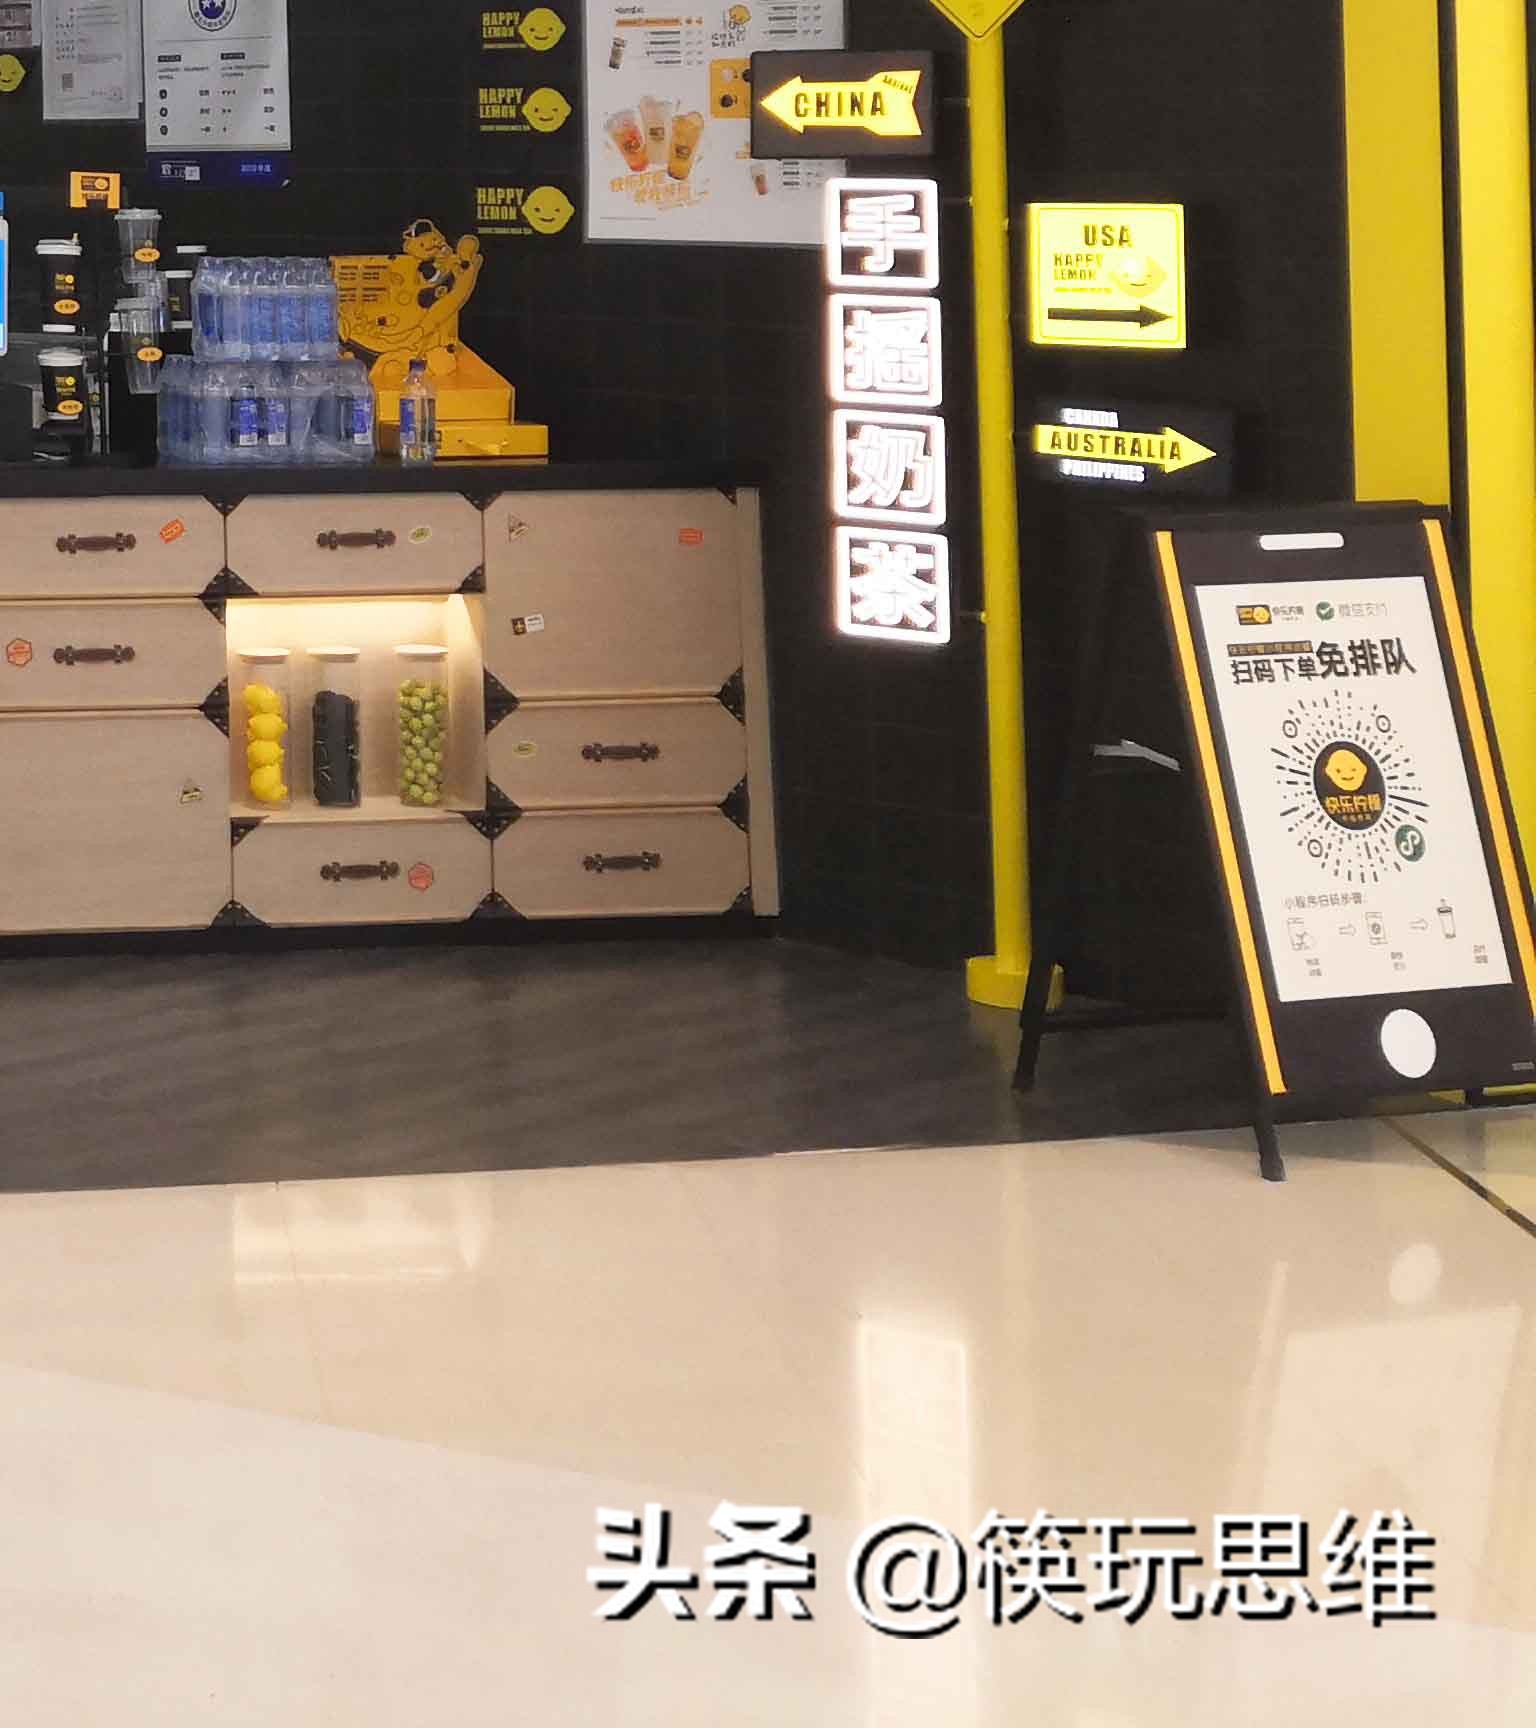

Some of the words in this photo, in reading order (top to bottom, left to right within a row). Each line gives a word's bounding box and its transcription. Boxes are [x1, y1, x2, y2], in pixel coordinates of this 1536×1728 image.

[481, 11, 520, 27] HAPPY
[481, 25, 516, 39] LEMON
[478, 87, 524, 105] HAPPY
[794, 91, 885, 118] CHINA
[479, 104, 517, 119] LEMON
[477, 187, 523, 206] HAPPY
[477, 204, 517, 221] LEMON
[1083, 224, 1134, 248] USA
[1054, 253, 1104, 268] HAPPY
[840, 192, 937, 629] 手摇奶茶
[1050, 430, 1183, 461] AUSTRALIA
[1324, 793, 1383, 815] 快乐柠檬
